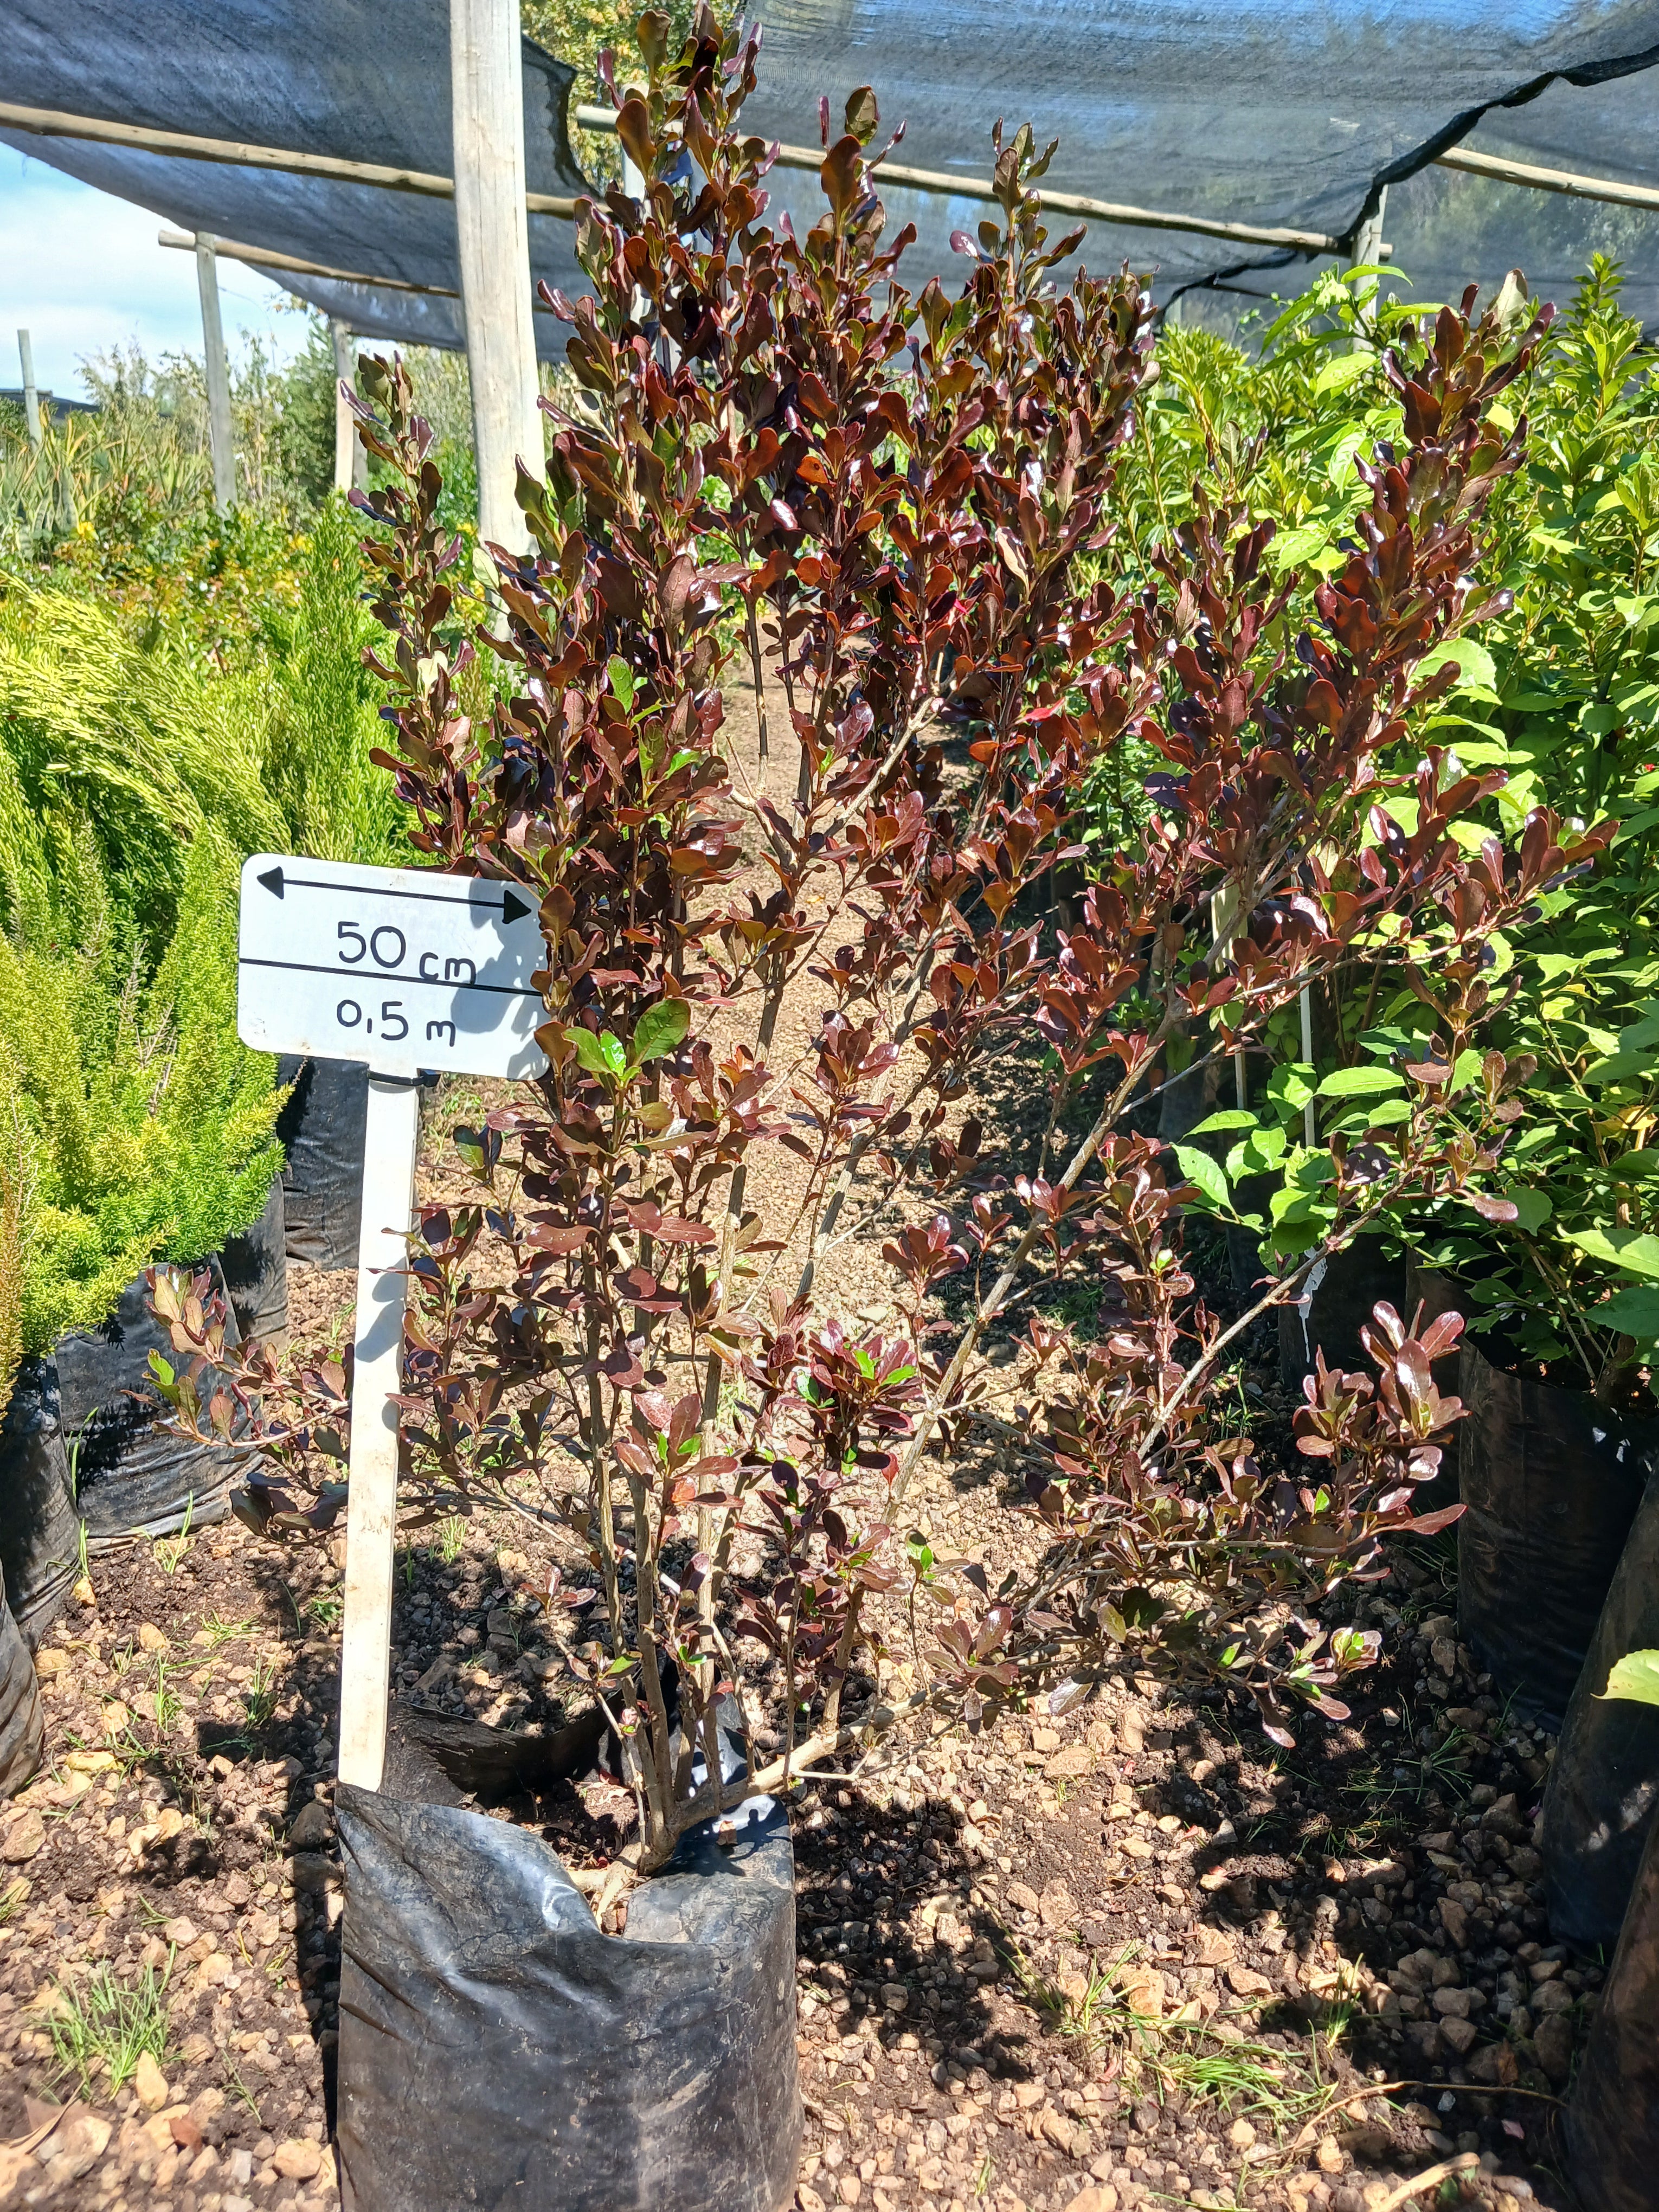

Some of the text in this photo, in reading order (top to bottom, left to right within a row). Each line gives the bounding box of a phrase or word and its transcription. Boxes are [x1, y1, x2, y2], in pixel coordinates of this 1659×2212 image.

[338, 921, 476, 985] 50 cm
[337, 999, 456, 1047] 0,5 m
